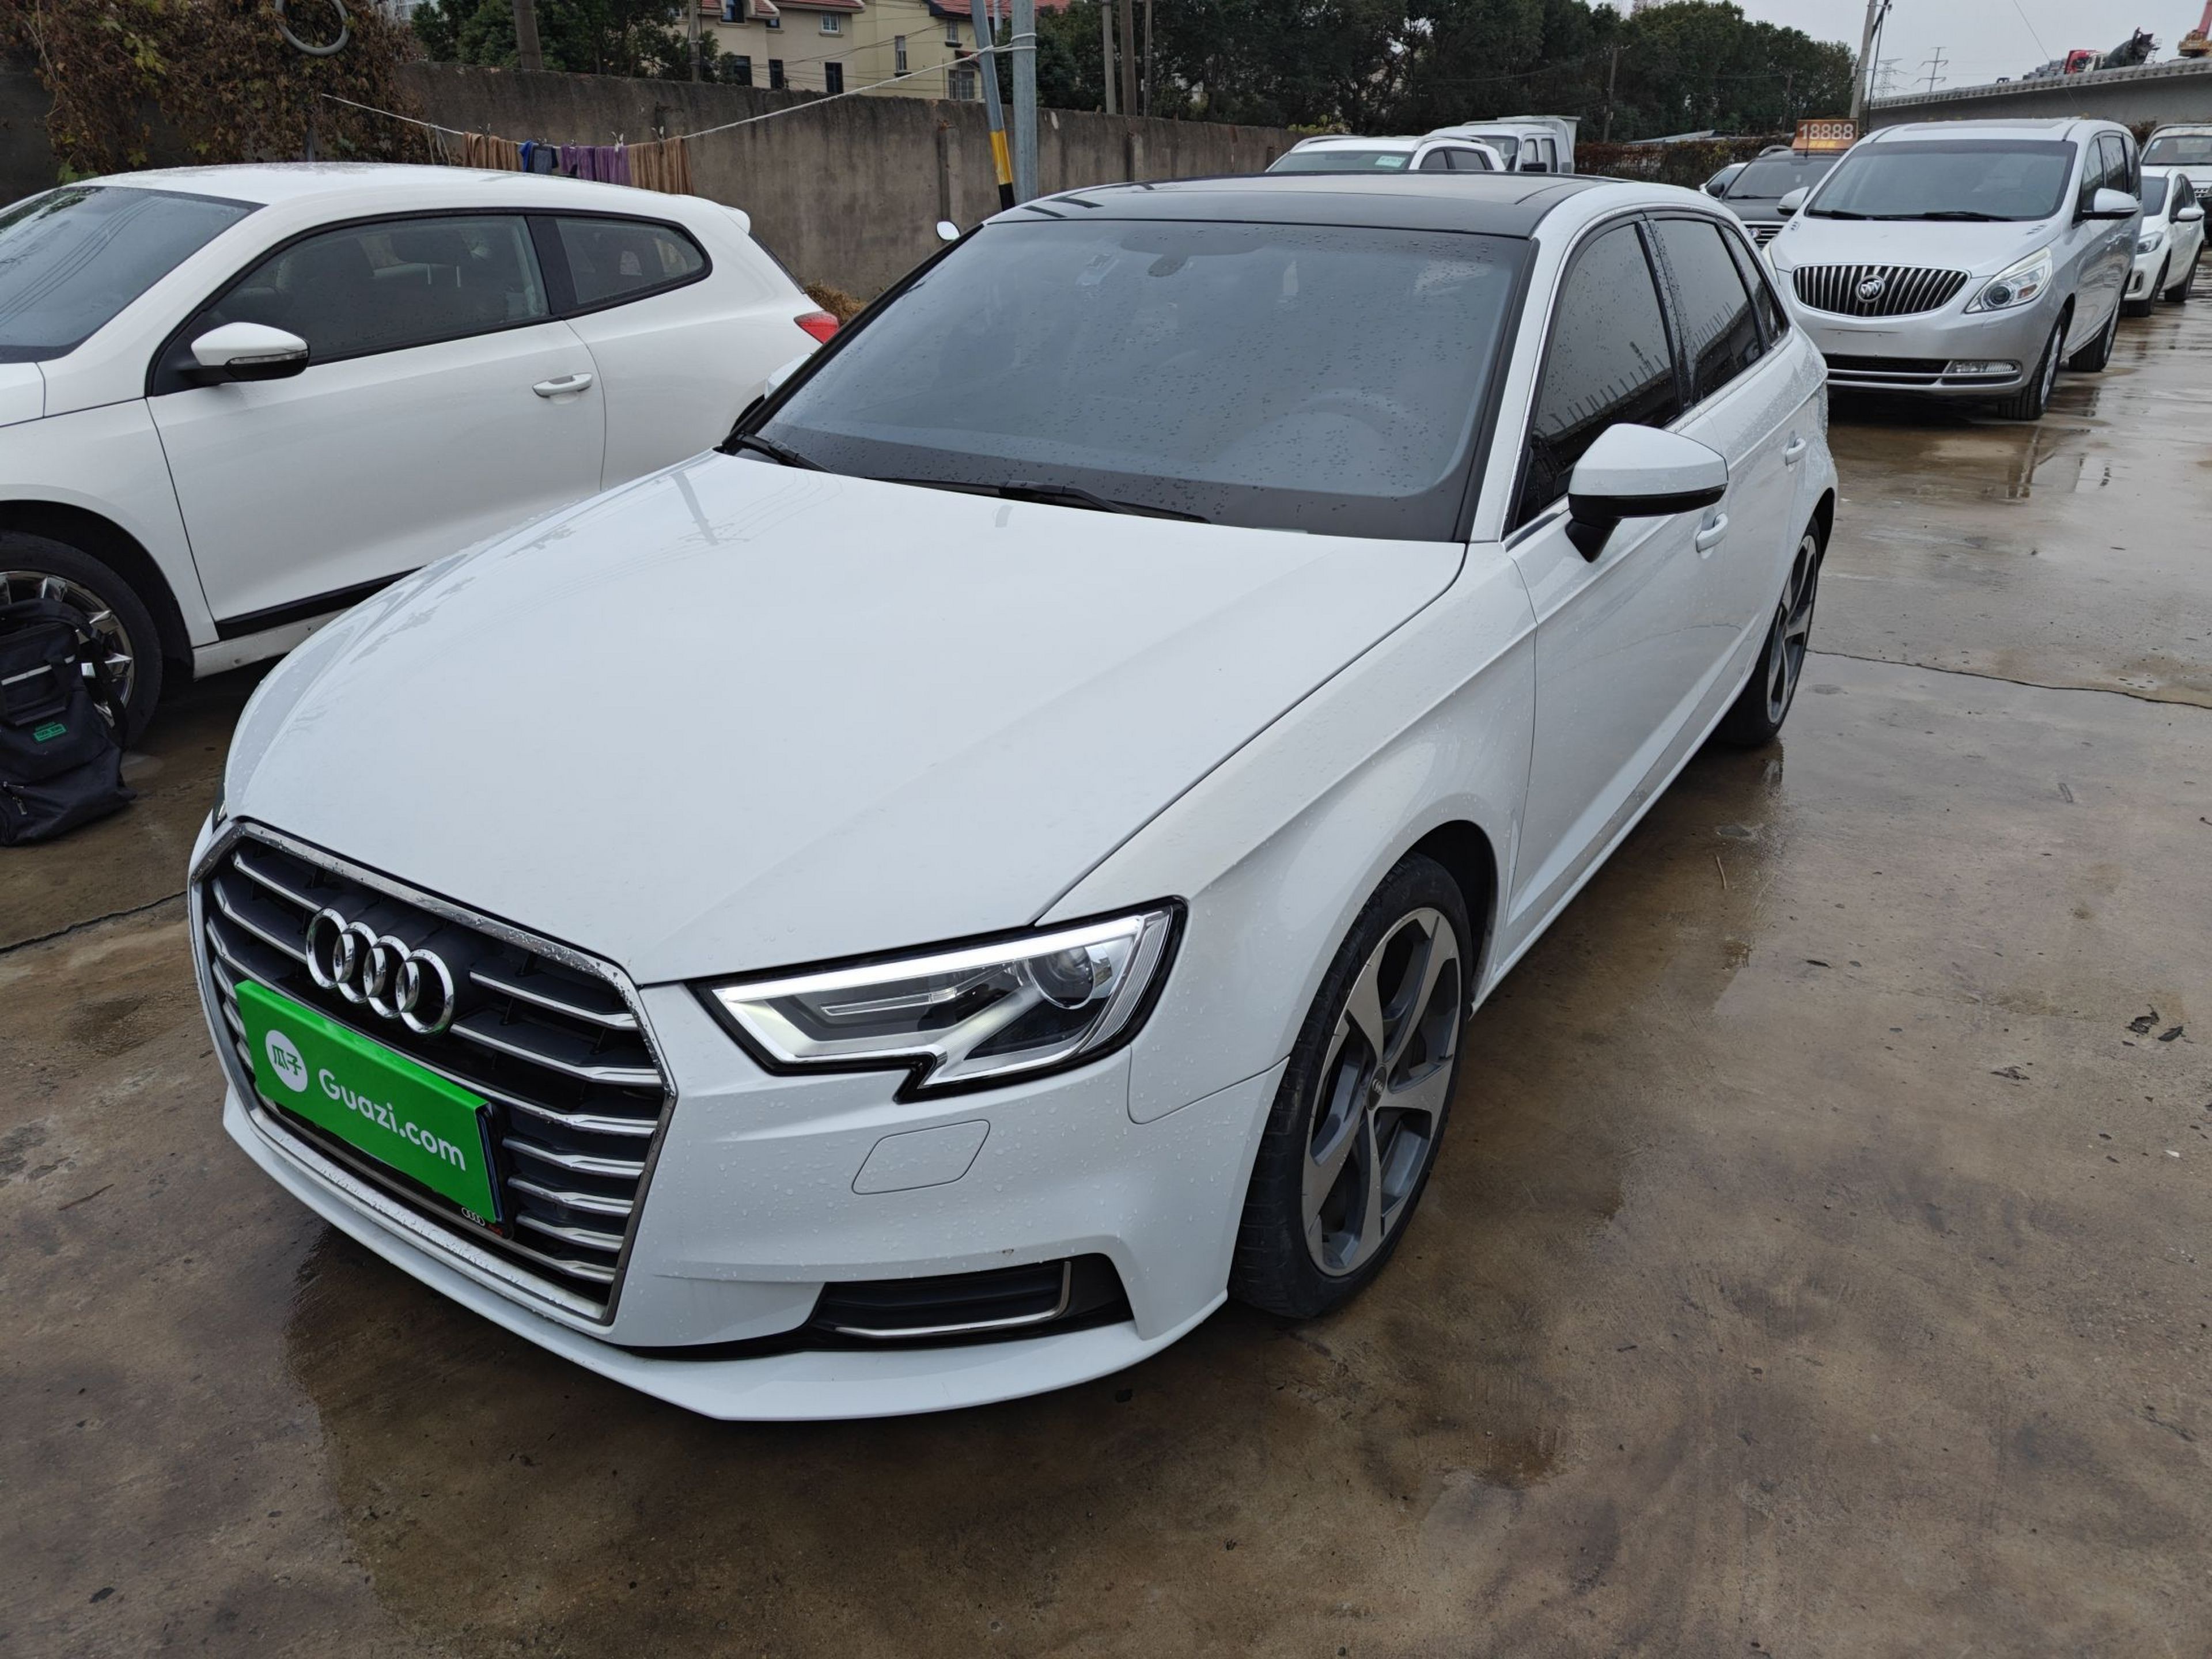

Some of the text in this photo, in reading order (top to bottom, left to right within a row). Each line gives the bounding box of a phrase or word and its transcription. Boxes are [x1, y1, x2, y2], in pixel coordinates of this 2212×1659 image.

[1800, 124, 1854, 139] 18888
[272, 1044, 302, 1076] 瓜子
[319, 1069, 466, 1171] Guazi.com
